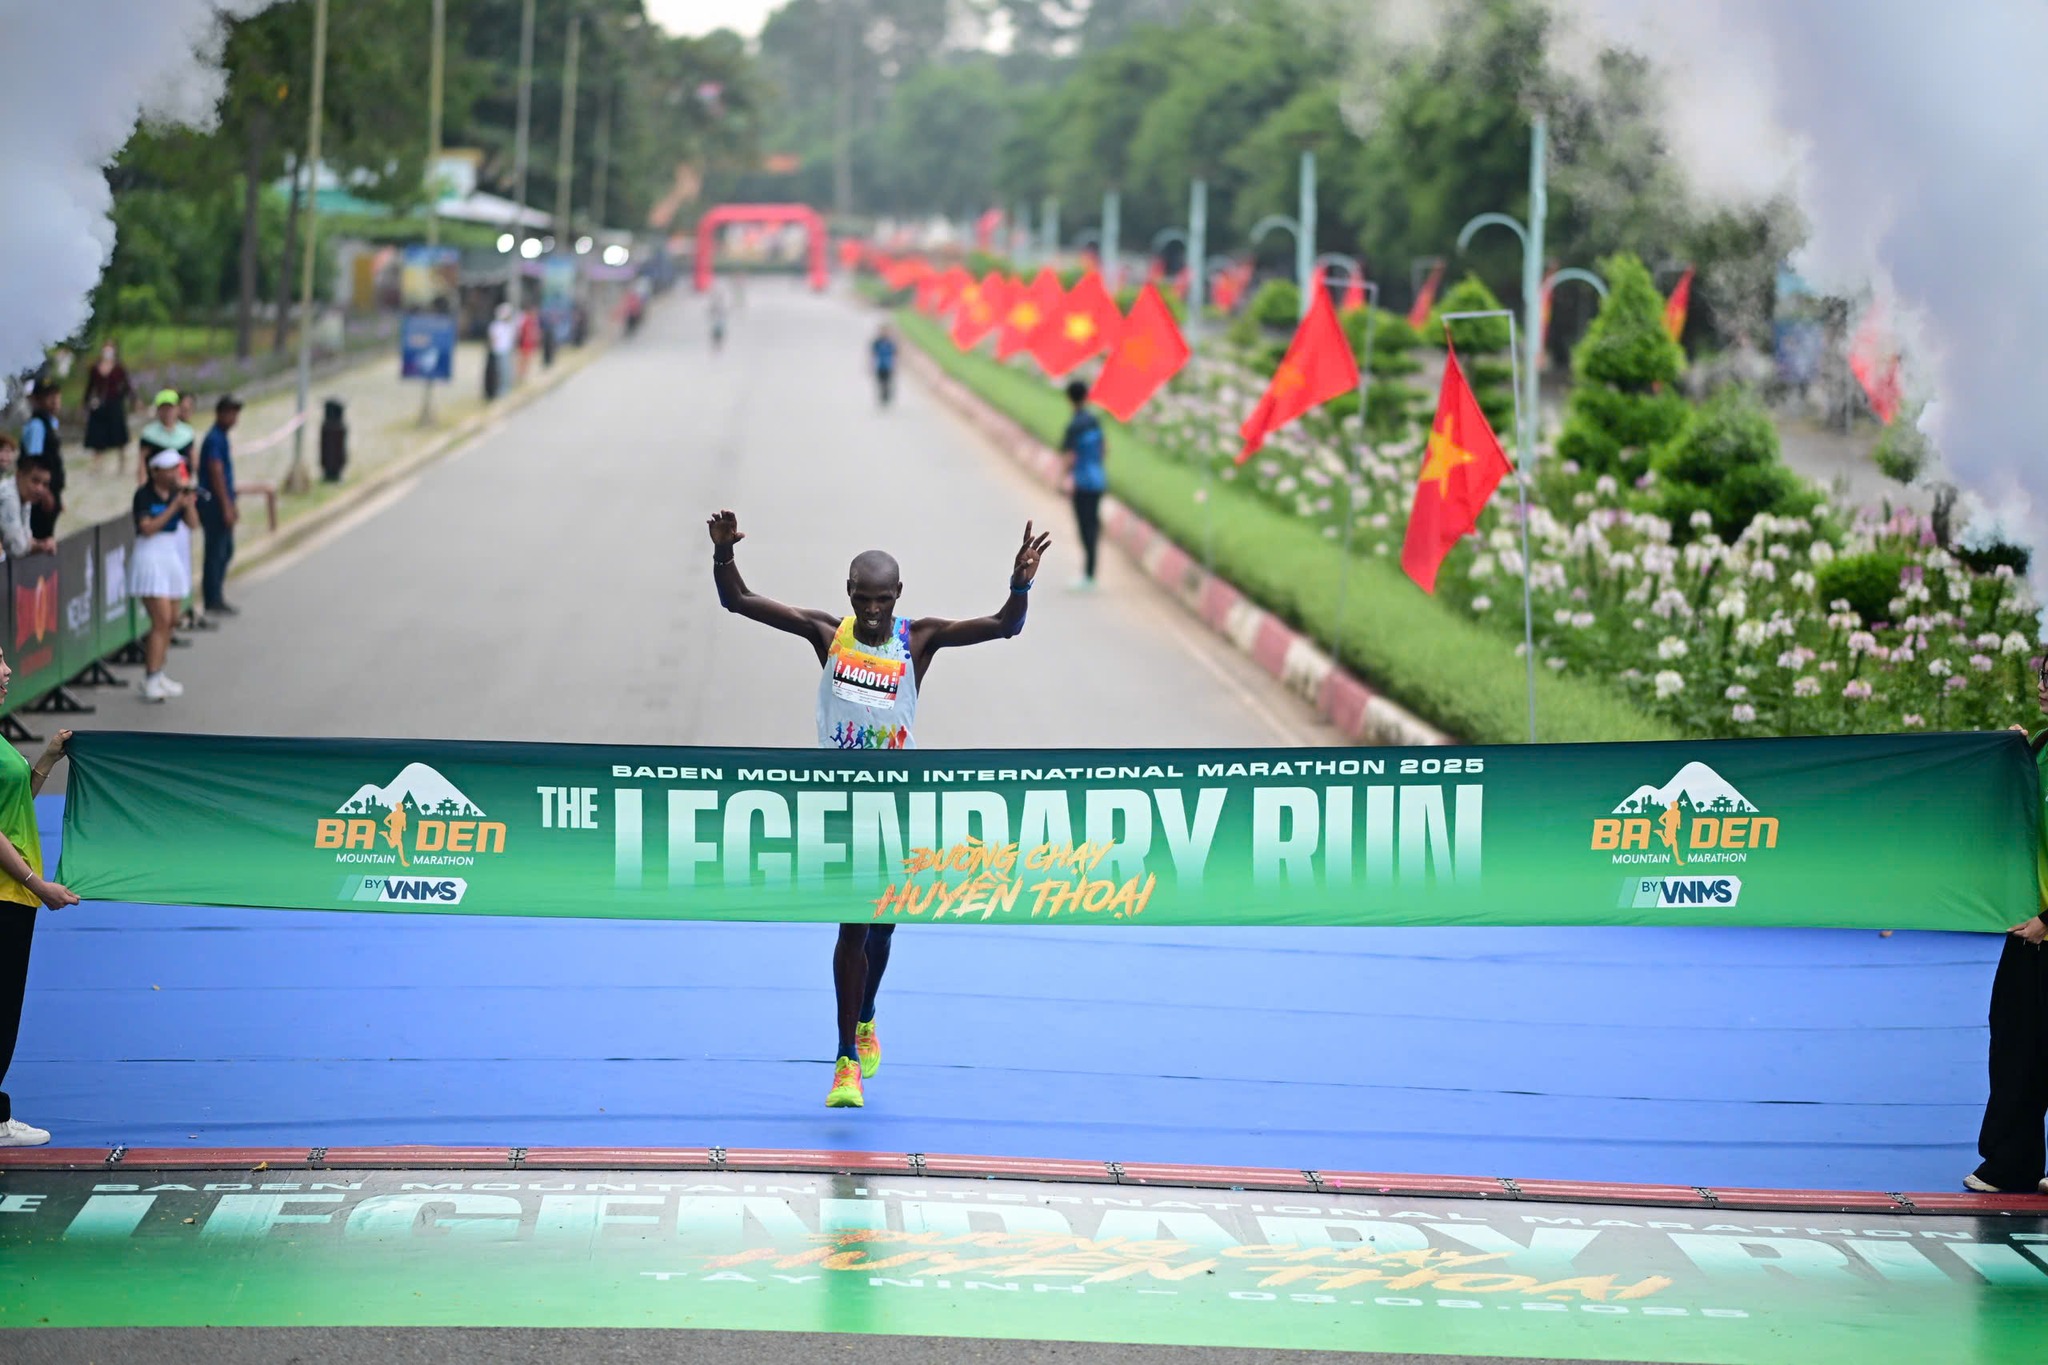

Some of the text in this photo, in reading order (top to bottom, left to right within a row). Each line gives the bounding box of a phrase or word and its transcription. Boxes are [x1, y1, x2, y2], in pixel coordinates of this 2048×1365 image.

[842, 665, 889, 689] A40014
[612, 758, 1484, 782] BADEN MOUNTAIN INTERNATIONAL MARATHON 2025
[537, 784, 1483, 890] THE LEGENDARY RUN
[336, 853, 474, 866] MOUNTAIN MARATHON
[1612, 852, 1747, 864] MOUNTAIN MARATHON
[365, 879, 457, 901] BY VNMS
[871, 871, 1157, 920] HUYỀN THOẠI
[1642, 880, 1732, 904] BY VNMS
[92, 1183, 1974, 1239] BADEN MOUNTAIN INTERNATIONAL MARATHON
[869, 1277, 1087, 1294] NINH
